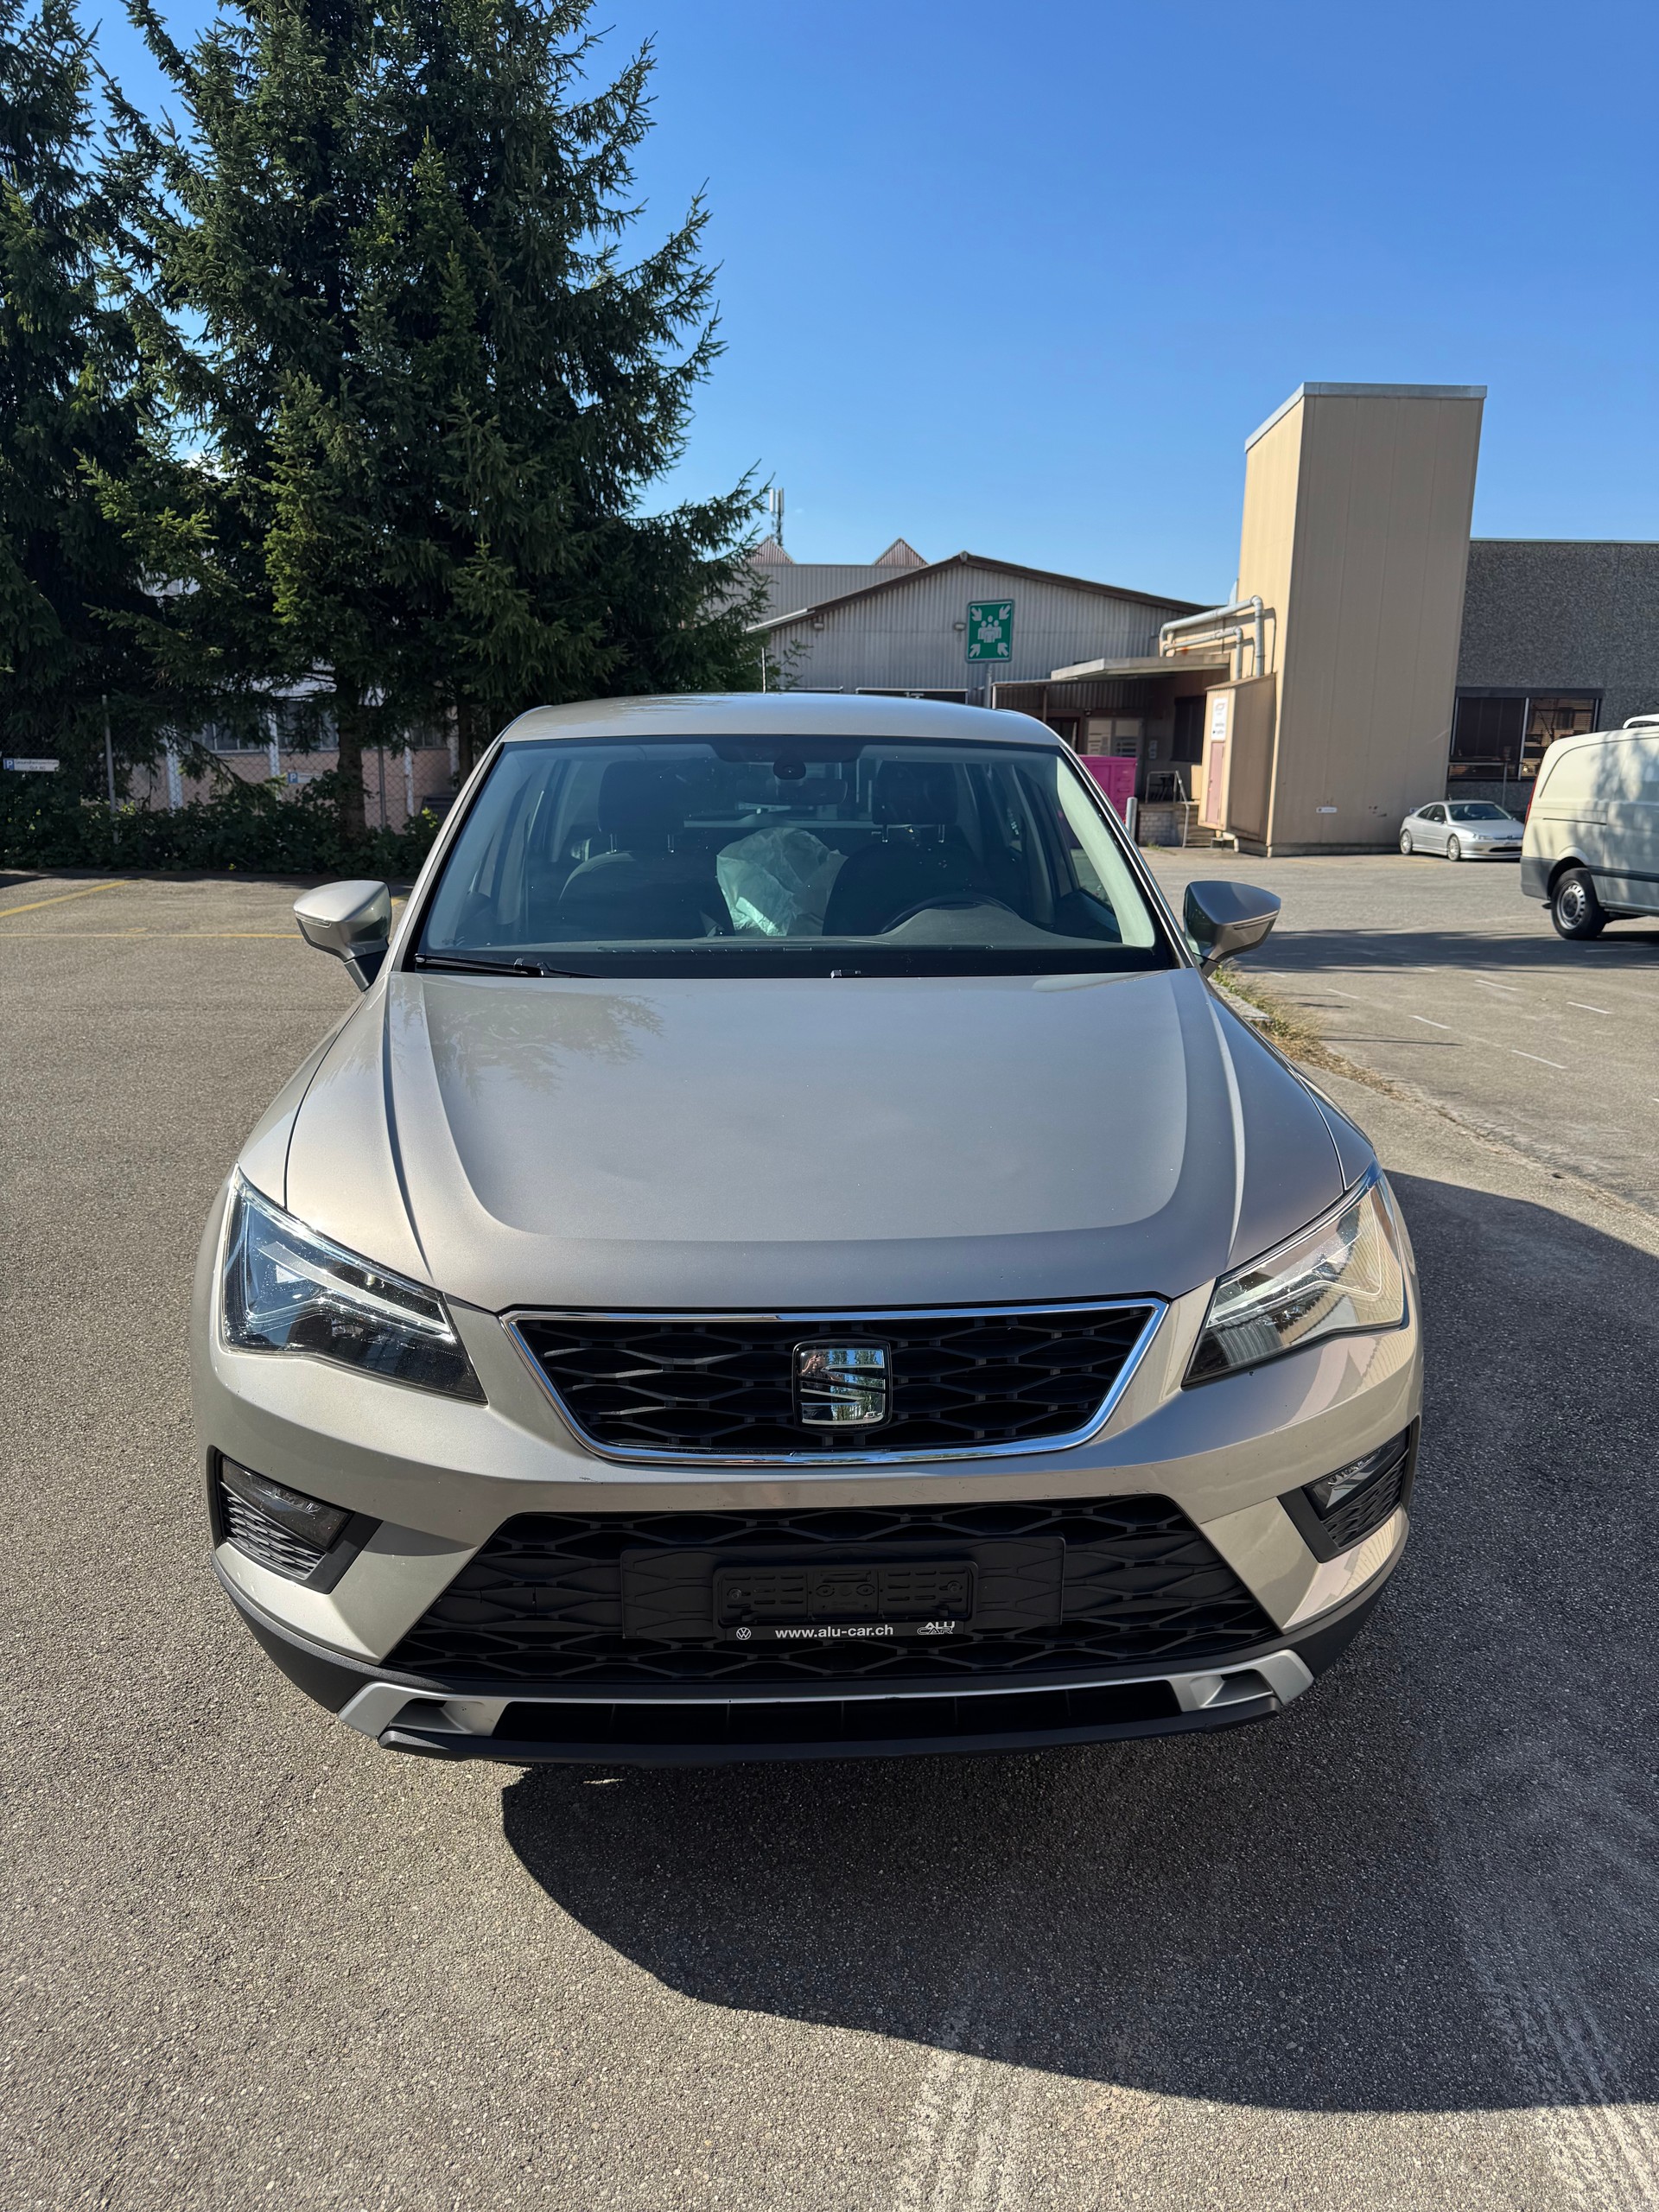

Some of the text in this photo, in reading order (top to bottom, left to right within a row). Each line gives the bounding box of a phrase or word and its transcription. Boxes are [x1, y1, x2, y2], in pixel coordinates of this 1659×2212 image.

[6, 760, 14, 769] P
[289, 772, 297, 783] P
[775, 1624, 893, 1638] www.alu-car.ch
